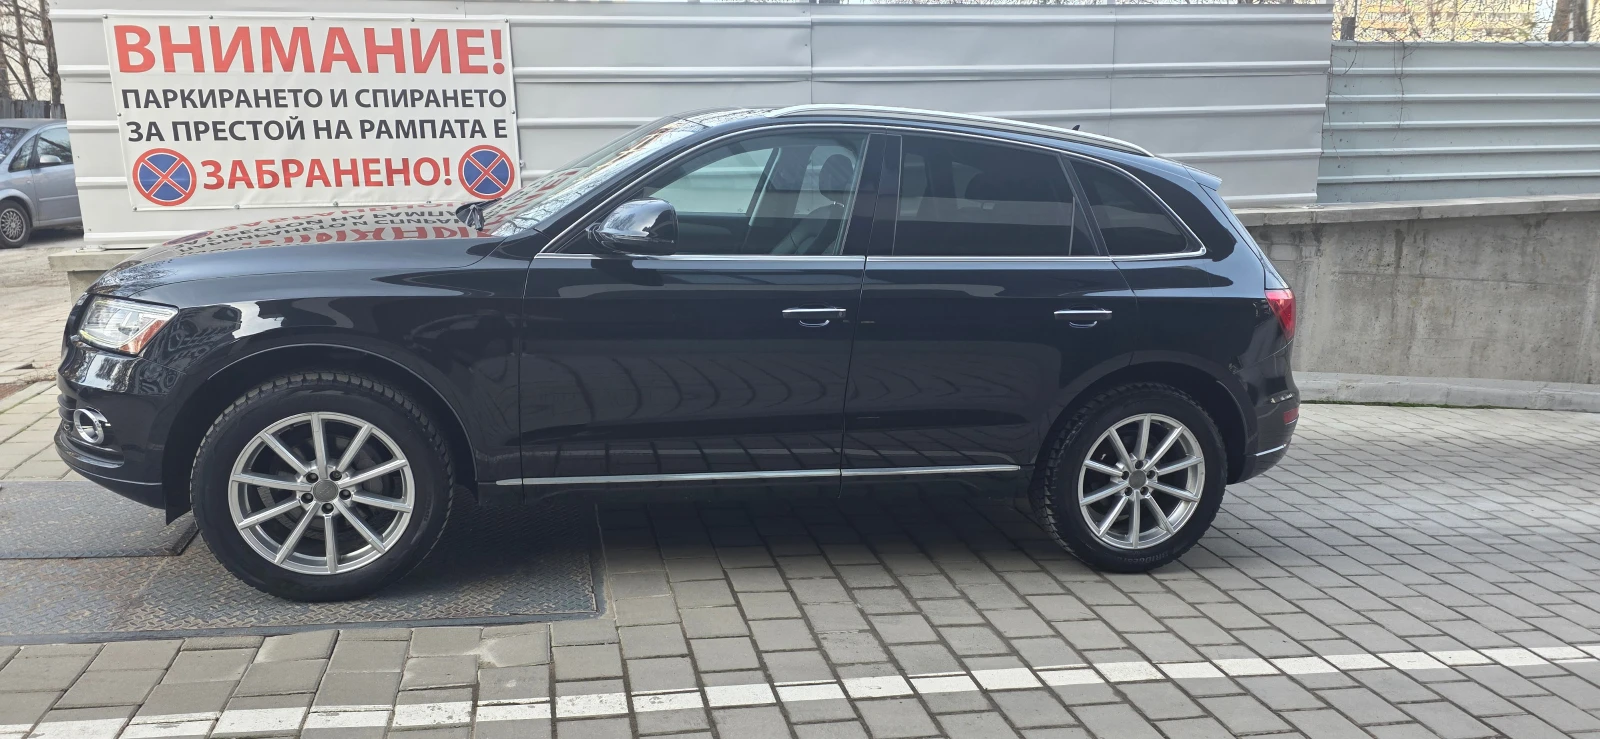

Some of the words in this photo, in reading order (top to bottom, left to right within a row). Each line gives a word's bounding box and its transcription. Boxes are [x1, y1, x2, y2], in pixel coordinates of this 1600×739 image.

[113, 24, 505, 75] ВНИМАНИЕ!
[121, 88, 323, 109] ПАРКИРАНЕТО
[329, 88, 348, 108] И
[354, 88, 507, 108] СПИРАНЕТО
[126, 120, 166, 142] ЗА
[171, 115, 306, 142] ПРЕСТОЙ
[312, 119, 353, 140] НА
[359, 119, 488, 140] РАМПАТА
[493, 119, 508, 139] Е
[201, 156, 452, 191] ЗАБРАНЕНО!
